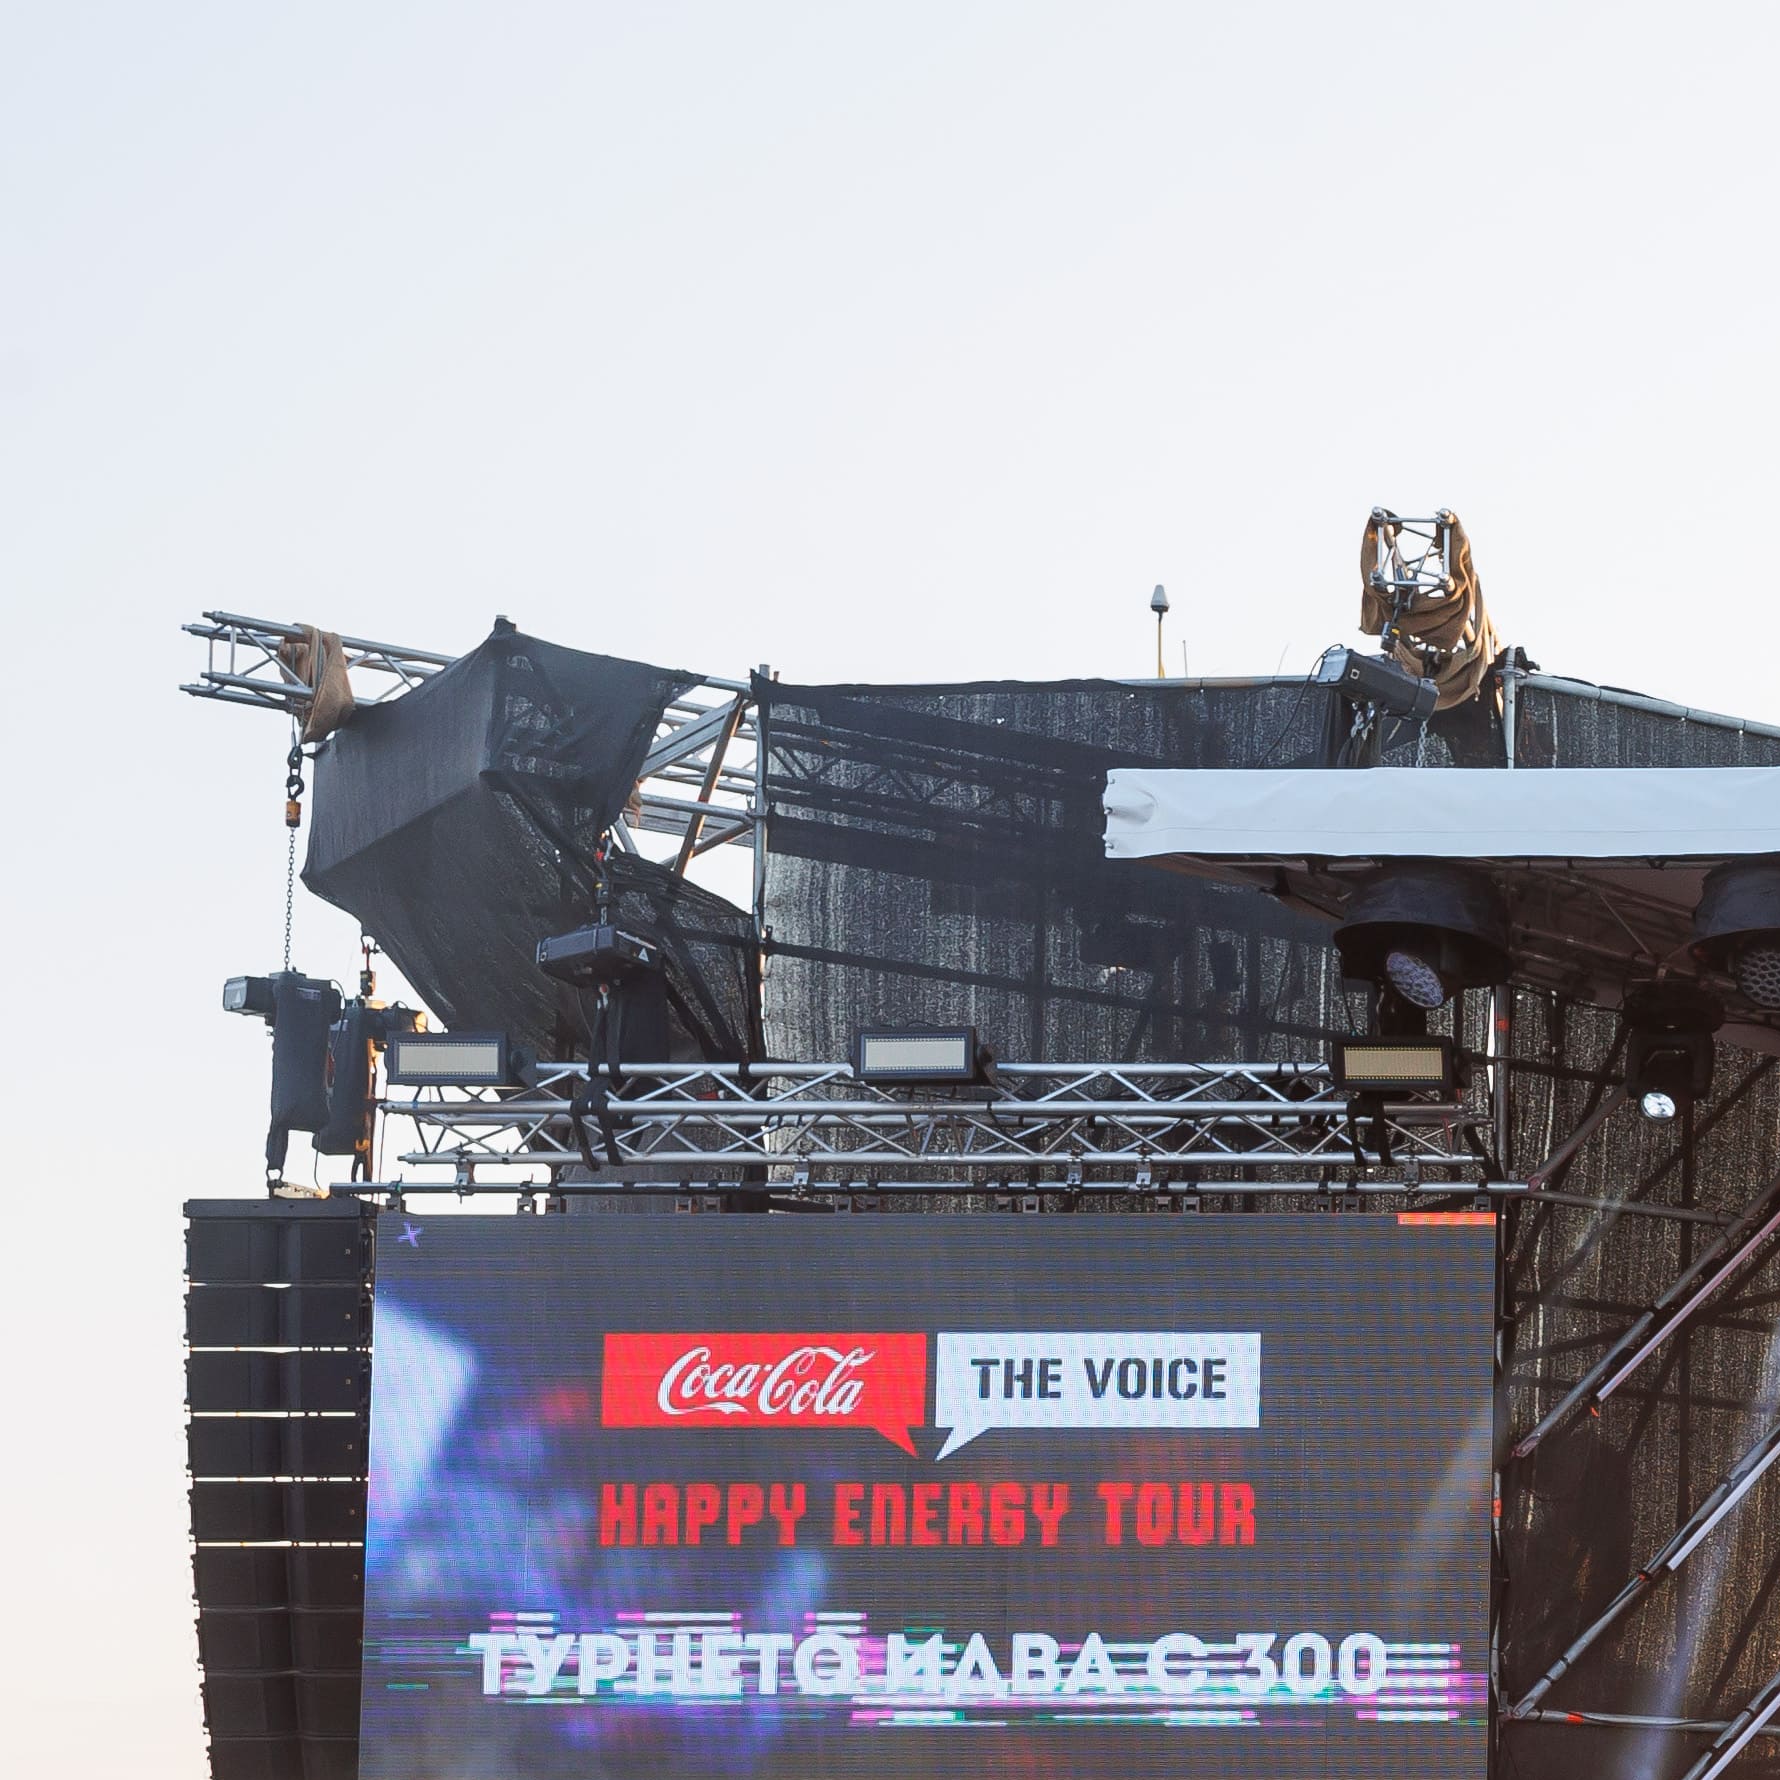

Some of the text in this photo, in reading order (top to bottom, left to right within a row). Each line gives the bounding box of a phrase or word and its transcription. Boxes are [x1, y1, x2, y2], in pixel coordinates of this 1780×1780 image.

[656, 1345, 877, 1416] Coca-Cola
[969, 1356, 1227, 1401] THE VOICE
[601, 1481, 1257, 1547] HAPPY ENERGY TOUR
[1233, 1631, 1387, 1696] 300
